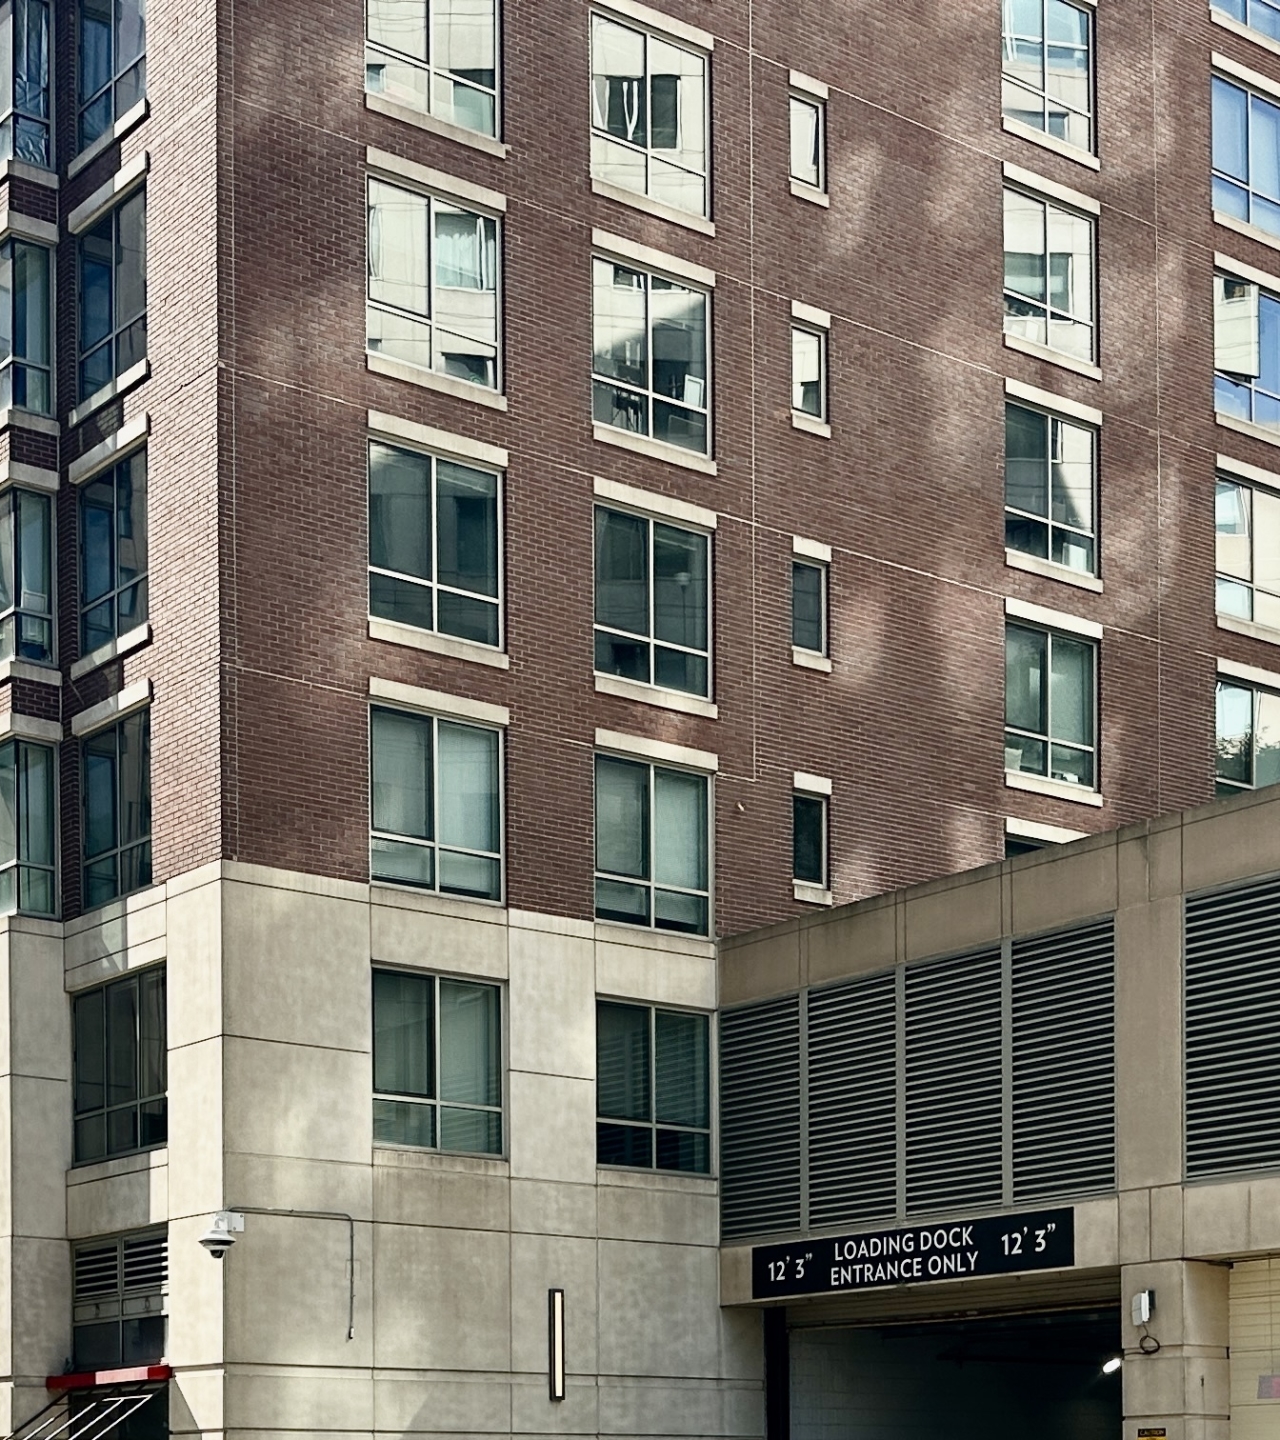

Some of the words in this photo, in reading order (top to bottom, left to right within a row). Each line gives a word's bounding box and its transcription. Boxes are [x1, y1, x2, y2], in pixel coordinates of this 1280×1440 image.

[834, 1233, 914, 1261] LOADING
[919, 1226, 974, 1251] DOCK
[830, 1257, 922, 1286] ENTRANCE
[928, 1251, 979, 1275] ONLY
